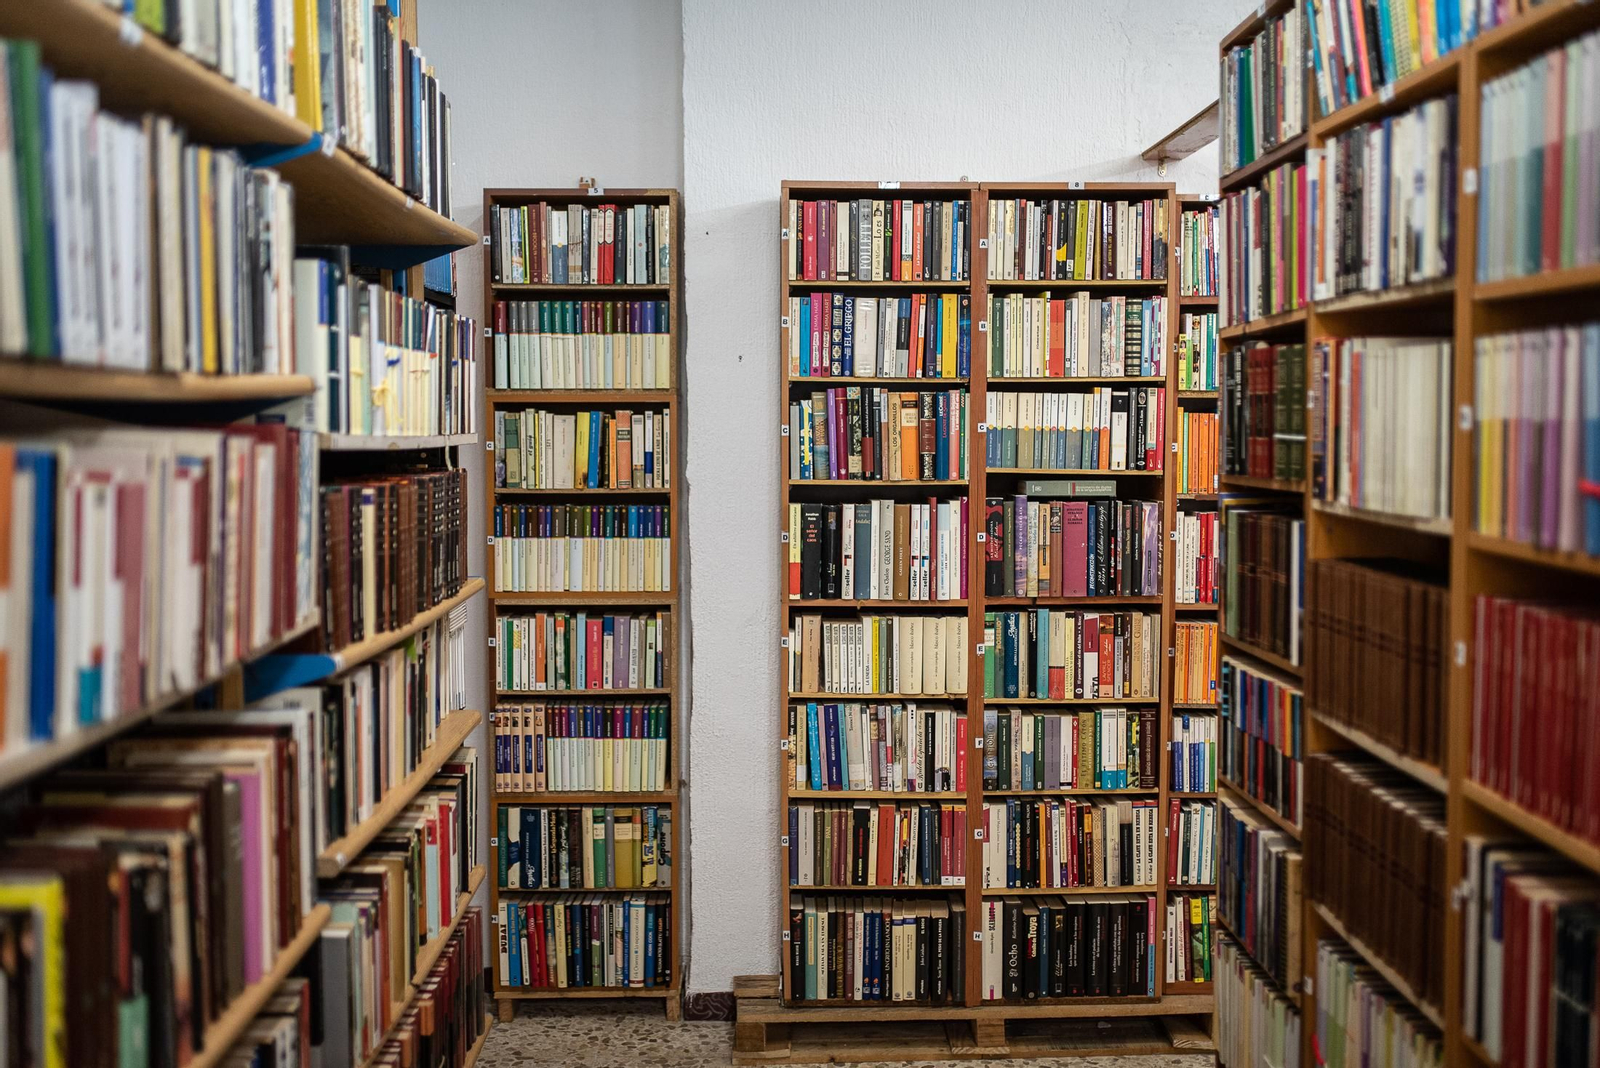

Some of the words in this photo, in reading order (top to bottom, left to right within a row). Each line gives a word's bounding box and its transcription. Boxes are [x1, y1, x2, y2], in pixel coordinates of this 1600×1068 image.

[860, 222, 871, 270] FOLLETT
[844, 335, 852, 346] EL
[658, 832, 670, 866] Capone
[1027, 916, 1038, 938] Troya
[1008, 944, 1018, 967] Ocho
